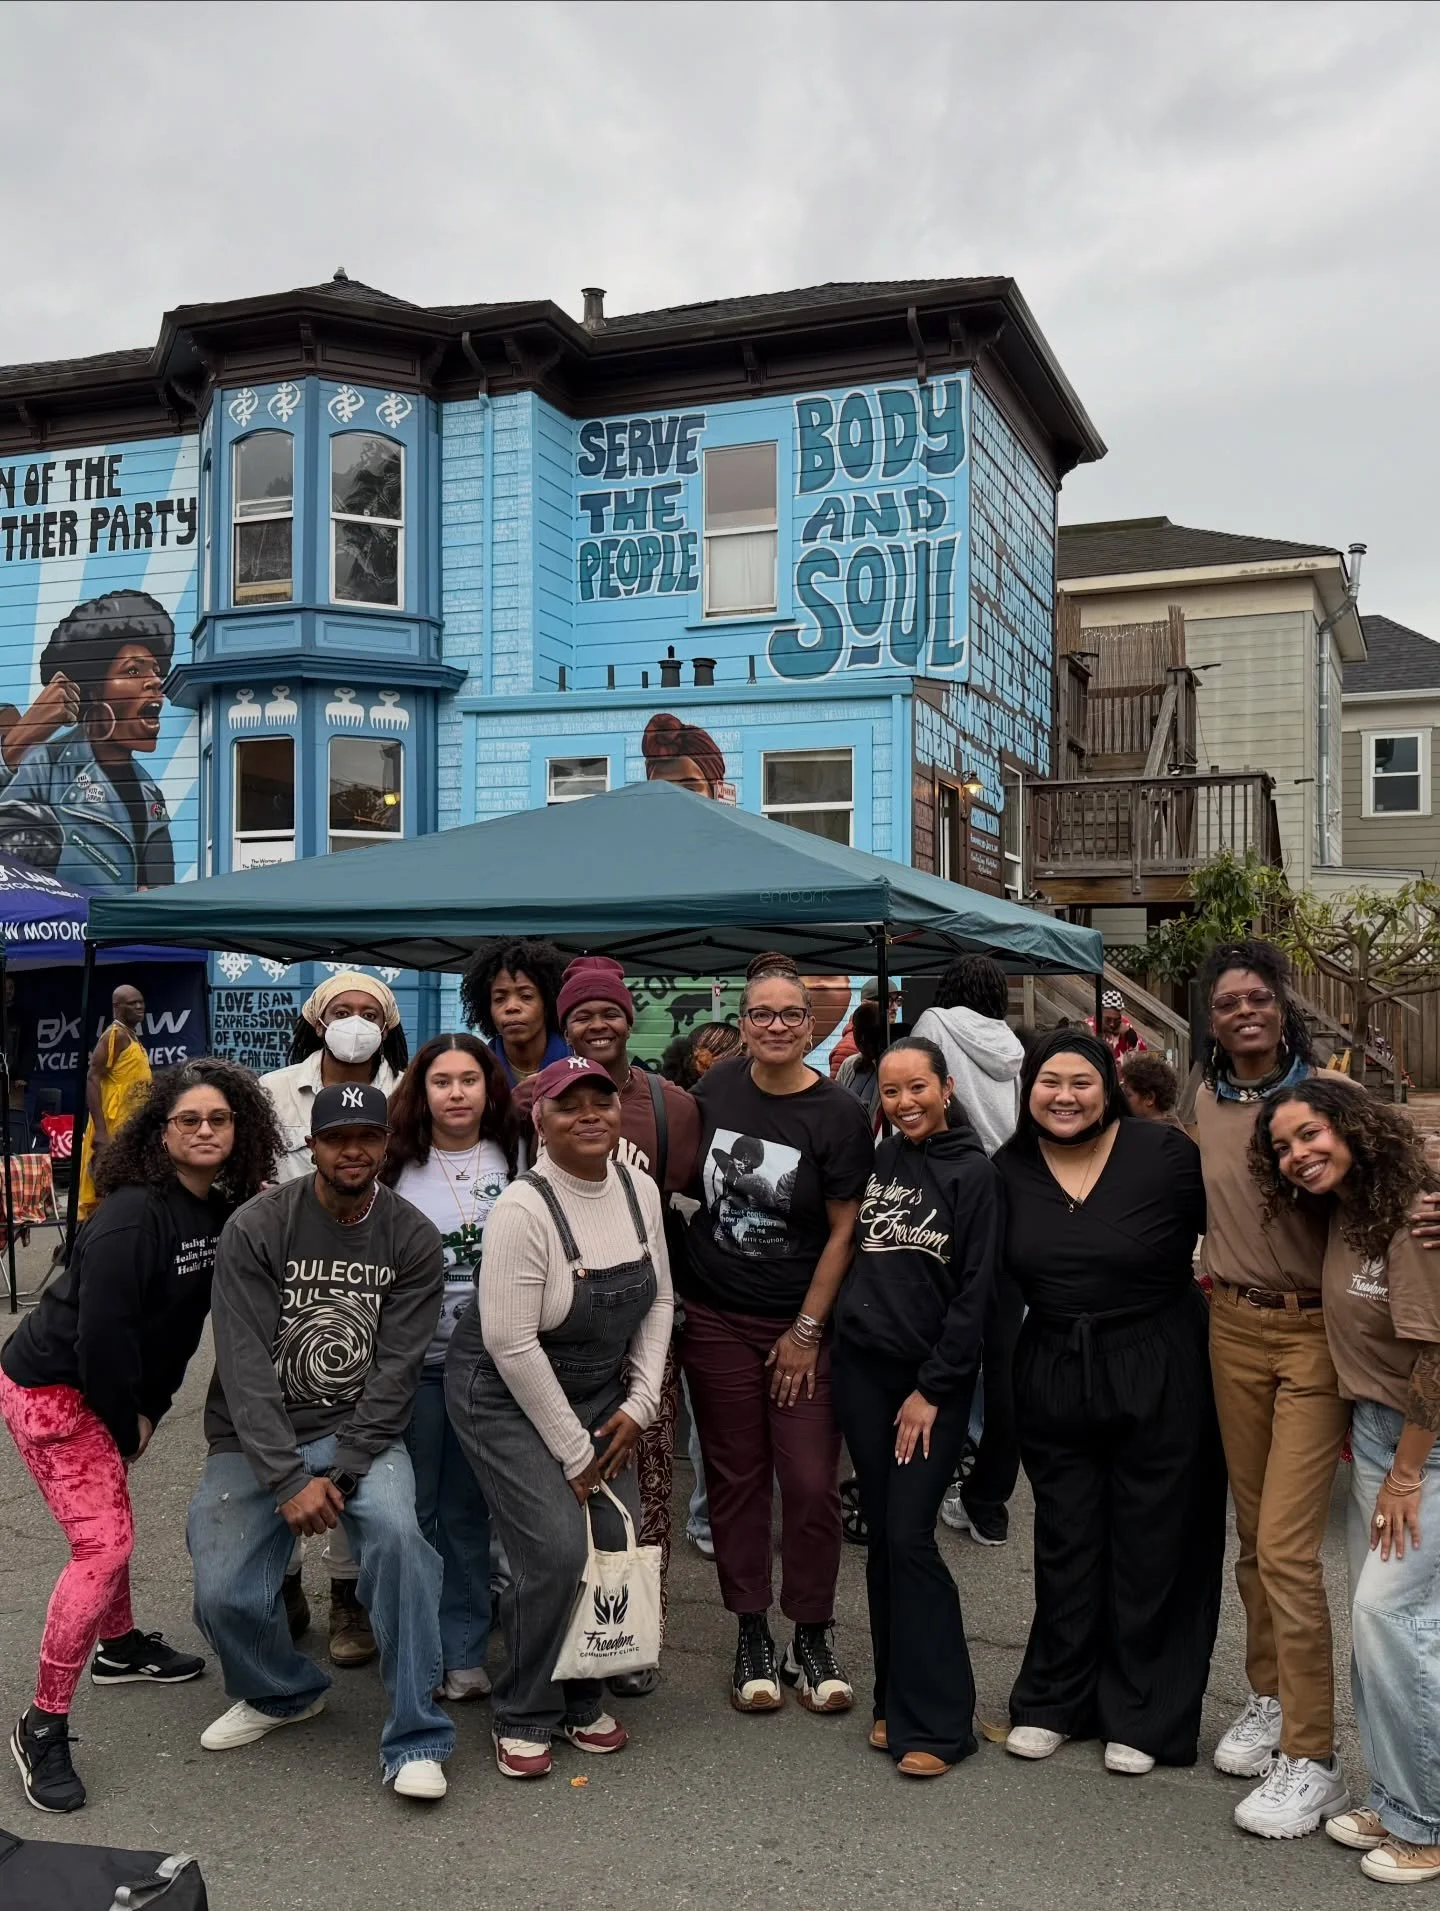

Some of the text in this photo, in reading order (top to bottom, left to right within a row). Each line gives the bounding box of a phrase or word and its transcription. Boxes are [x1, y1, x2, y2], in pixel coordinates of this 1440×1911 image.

[577, 412, 707, 482] SERVE
[793, 377, 968, 496] BODY
[24, 461, 56, 506] OF
[65, 454, 123, 501] THE
[89, 497, 197, 553] PARTY
[577, 480, 687, 536] THE
[800, 484, 950, 545] AND
[578, 530, 700, 602] PEOPLE
[766, 532, 968, 684] SOUL
[970, 589, 1051, 732] LOVES YOU
[915, 697, 956, 781] GREAT
[960, 734, 1004, 815] THINGS
[991, 698, 1013, 766] YOU
[1015, 710, 1034, 768] CAN
[1037, 727, 1049, 780] DO
[214, 1008, 298, 1031] EXPRESSION
[215, 991, 293, 1014] LOVE IS AN
[35, 1052, 79, 1071] YCLE
[214, 1030, 292, 1051] OF POWER
[239, 1050, 261, 1068] CAN
[263, 1051, 281, 1067] USE
[341, 1086, 364, 1108] NY
[584, 1630, 635, 1652] Freedom
[619, 1646, 640, 1655] CLINIC
[1298, 1783, 1310, 1798] FILA
